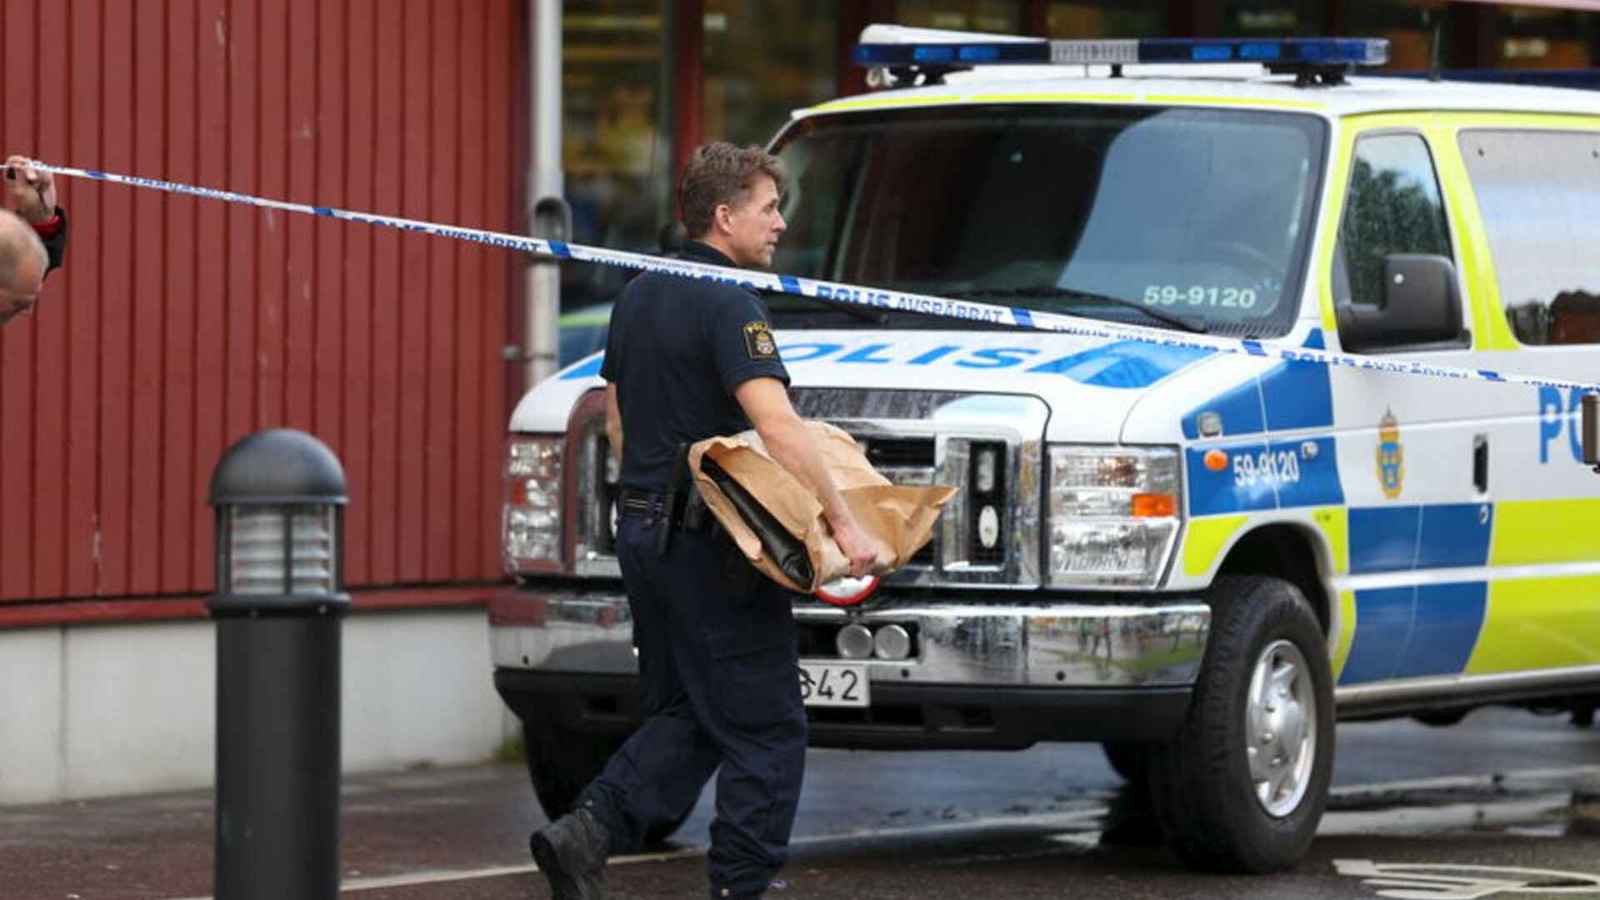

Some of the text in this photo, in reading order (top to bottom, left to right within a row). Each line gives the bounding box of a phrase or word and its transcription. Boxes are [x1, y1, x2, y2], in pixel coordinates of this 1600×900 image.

[816, 285, 1003, 322] POLIS AVSPÄRRAT
[1143, 285, 1256, 308] 59-9120
[779, 343, 1042, 368] OLIS
[1233, 450, 1300, 487] 59-9120
